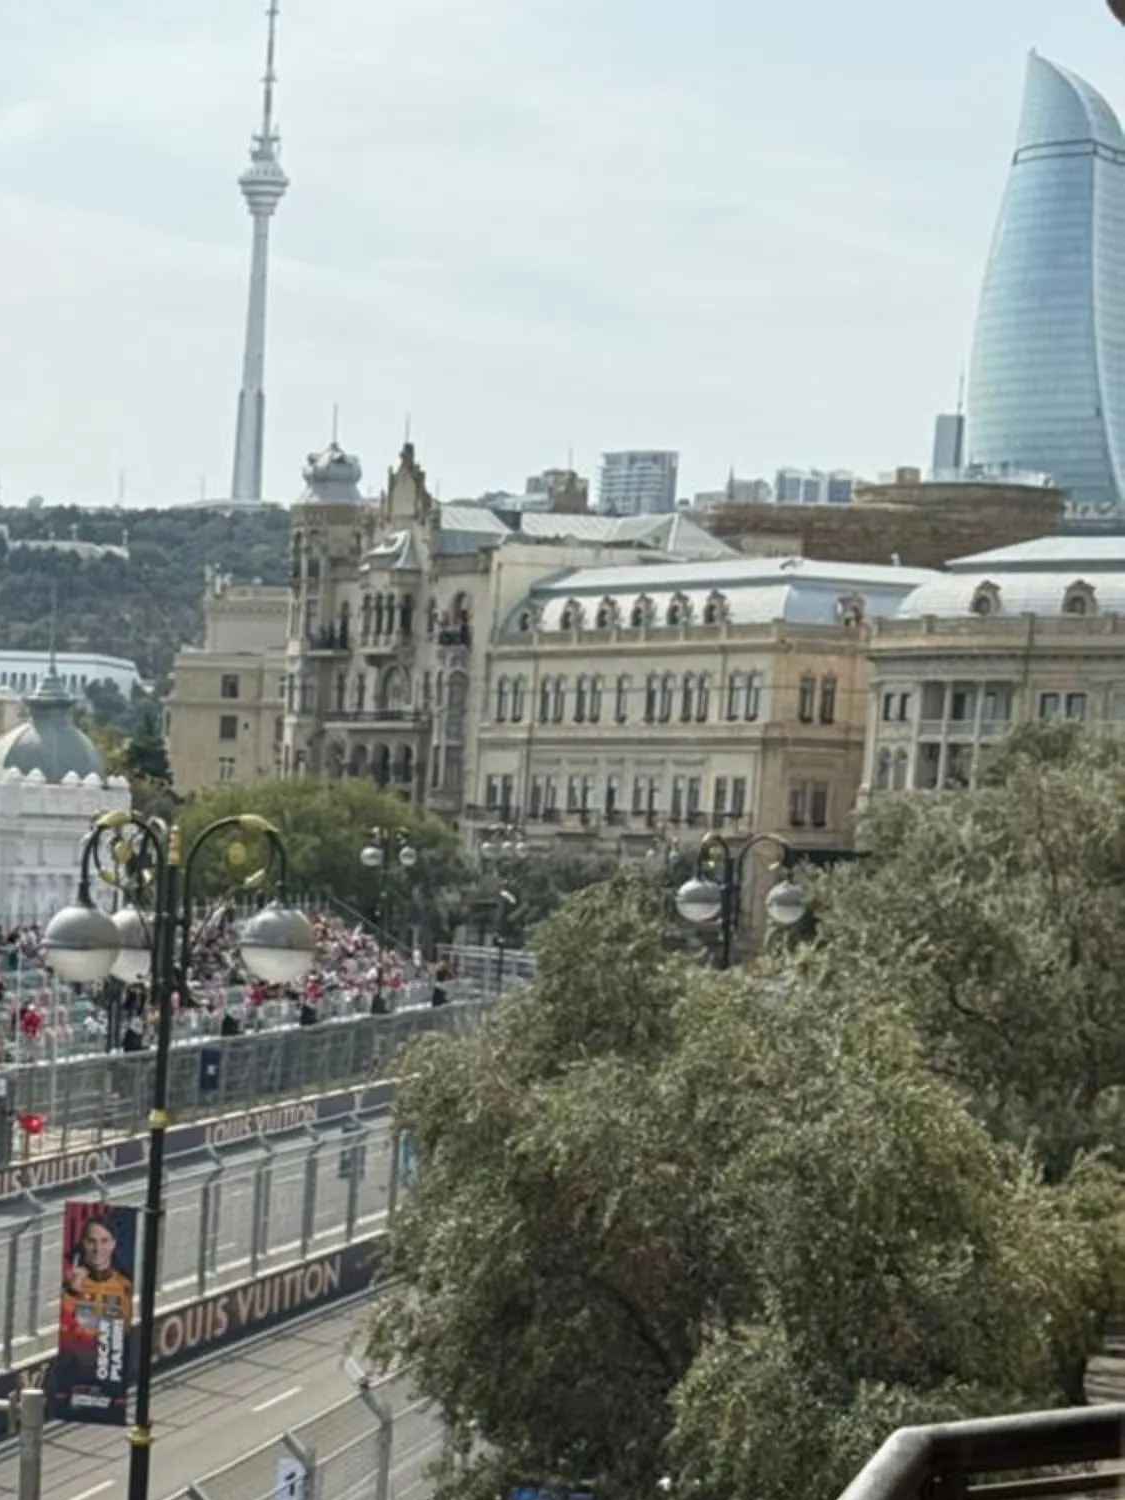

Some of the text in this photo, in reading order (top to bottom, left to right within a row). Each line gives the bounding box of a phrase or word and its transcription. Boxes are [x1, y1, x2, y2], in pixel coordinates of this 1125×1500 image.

[27, 1147, 116, 1187] VUITTON
[150, 1254, 343, 1362] OUIS VUITTON
